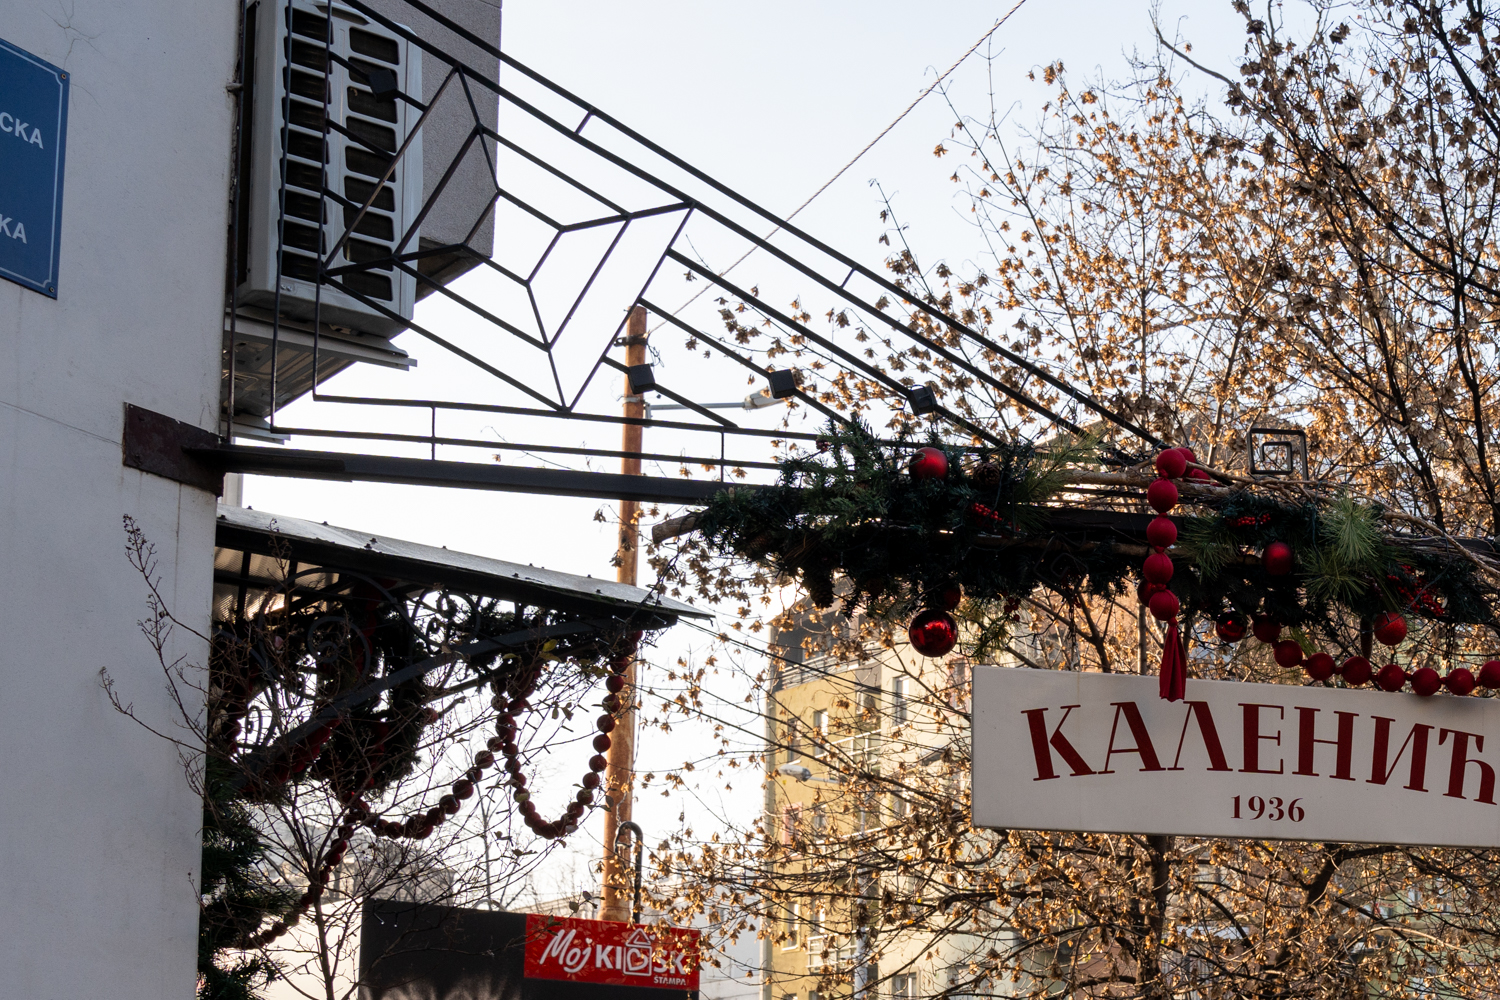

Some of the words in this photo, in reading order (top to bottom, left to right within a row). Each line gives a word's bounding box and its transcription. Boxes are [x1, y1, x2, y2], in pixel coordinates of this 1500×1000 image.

[1020, 700, 1499, 807] КАЛЕНИЋ
[1230, 794, 1306, 824] 1936
[538, 928, 593, 974] Moj
